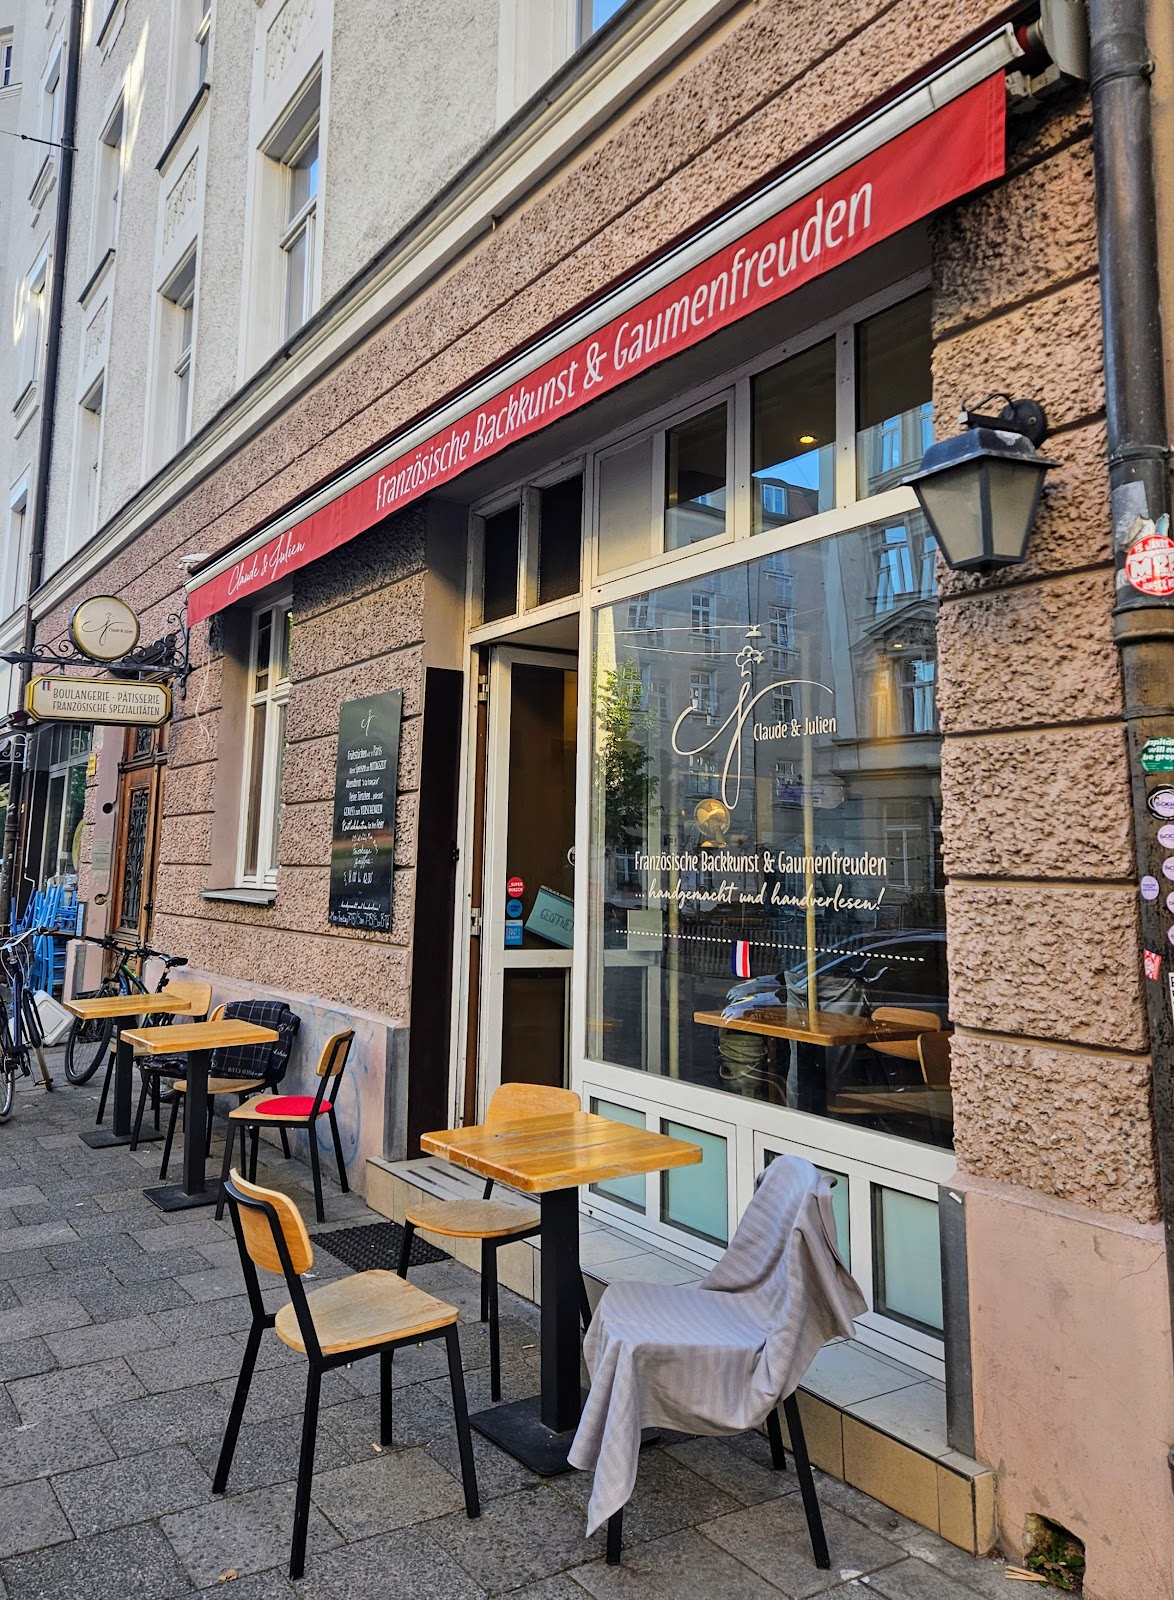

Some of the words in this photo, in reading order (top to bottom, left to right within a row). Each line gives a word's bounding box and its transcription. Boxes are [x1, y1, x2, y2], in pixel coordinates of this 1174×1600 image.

[376, 430, 470, 511] Französische
[473, 361, 578, 453] Backkunst
[583, 341, 607, 389] &
[613, 182, 873, 371] Gaumenfreuden
[227, 554, 260, 595] Claude
[260, 552, 268, 577] &
[269, 532, 305, 579] Julien
[52, 700, 107, 713] FRANZÖSISCHE
[109, 704, 160, 716] SPEZIALITÄTEN
[53, 688, 109, 701] BOULANGERIE
[117, 691, 160, 705] PÂTISSERIE
[753, 721, 787, 741] Claude
[791, 718, 801, 737] &
[803, 715, 836, 736] Julien
[634, 850, 698, 871] Französische
[702, 850, 759, 873] Backkunst
[764, 851, 775, 873] &
[778, 850, 887, 876] Gaumenfreuden
[648, 878, 739, 910] handgemacht
[740, 882, 767, 905] und
[771, 882, 885, 912] handverlesen!
